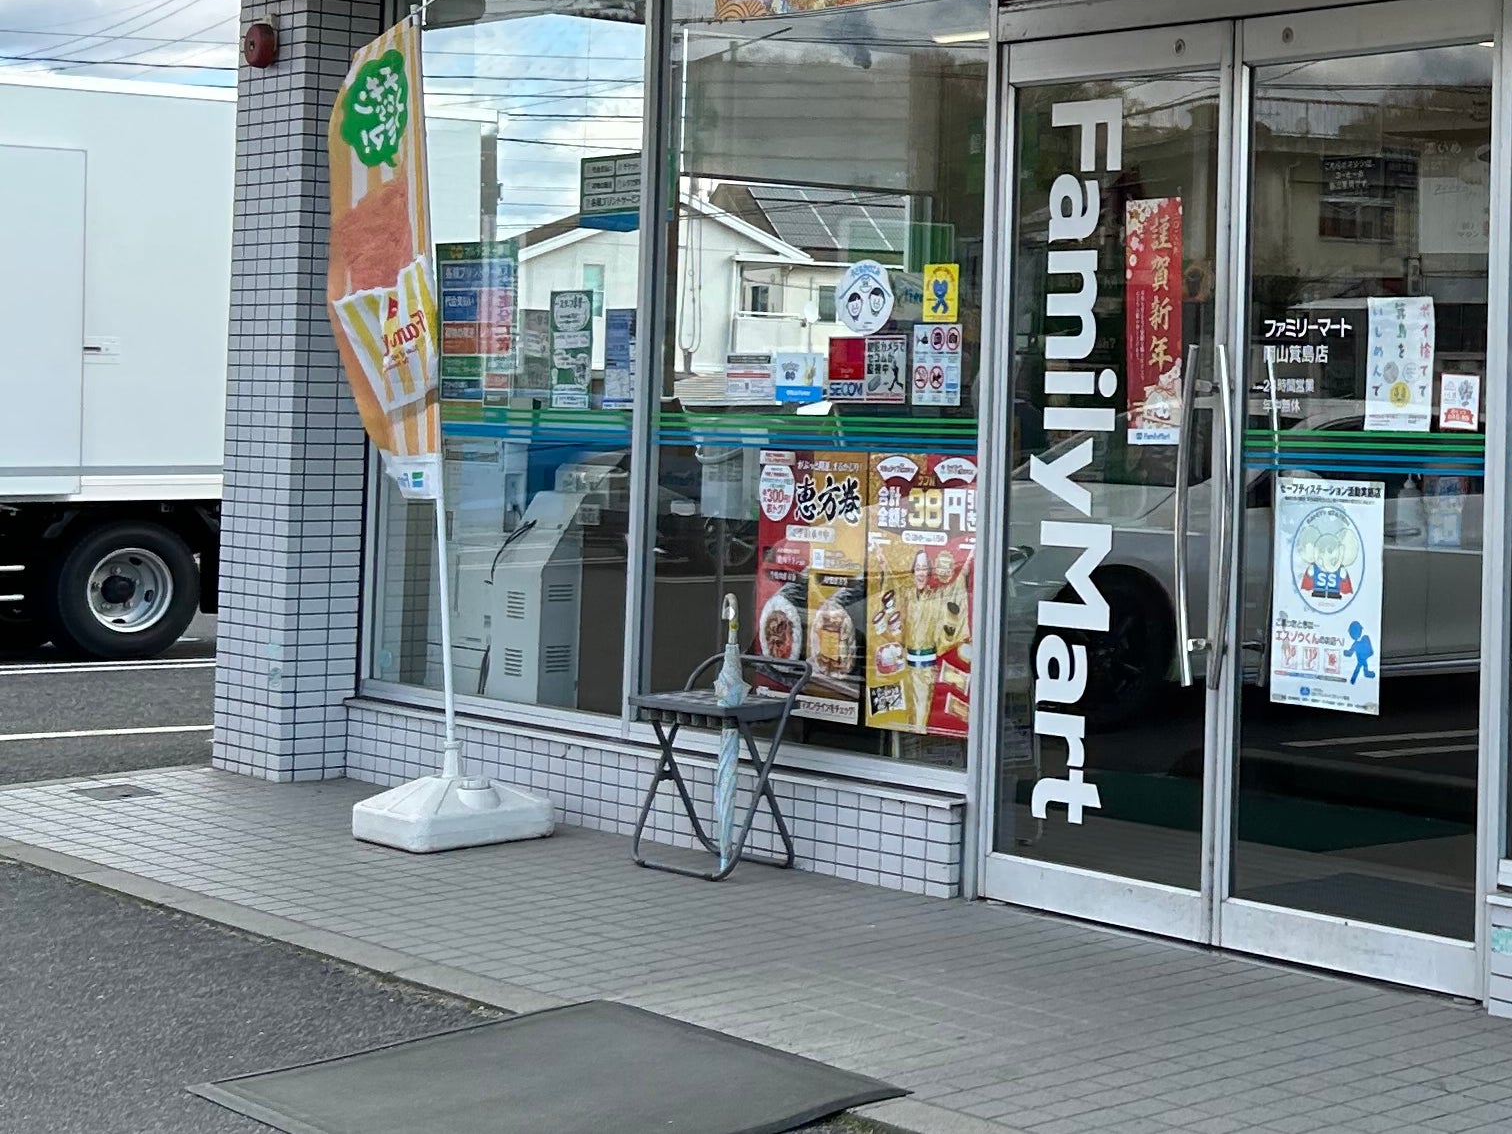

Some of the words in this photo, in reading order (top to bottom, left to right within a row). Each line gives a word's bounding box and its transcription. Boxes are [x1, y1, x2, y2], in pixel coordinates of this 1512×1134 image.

[1149, 214, 1174, 372] 謹賀新年
[1264, 317, 1353, 338] ファミリーマート
[828, 381, 863, 397] SECOM
[1263, 378, 1315, 393] 2時間営業
[1030, 97, 1123, 826] FamilyMart
[797, 475, 861, 525] 恵方巻
[1317, 572, 1337, 587] SS
